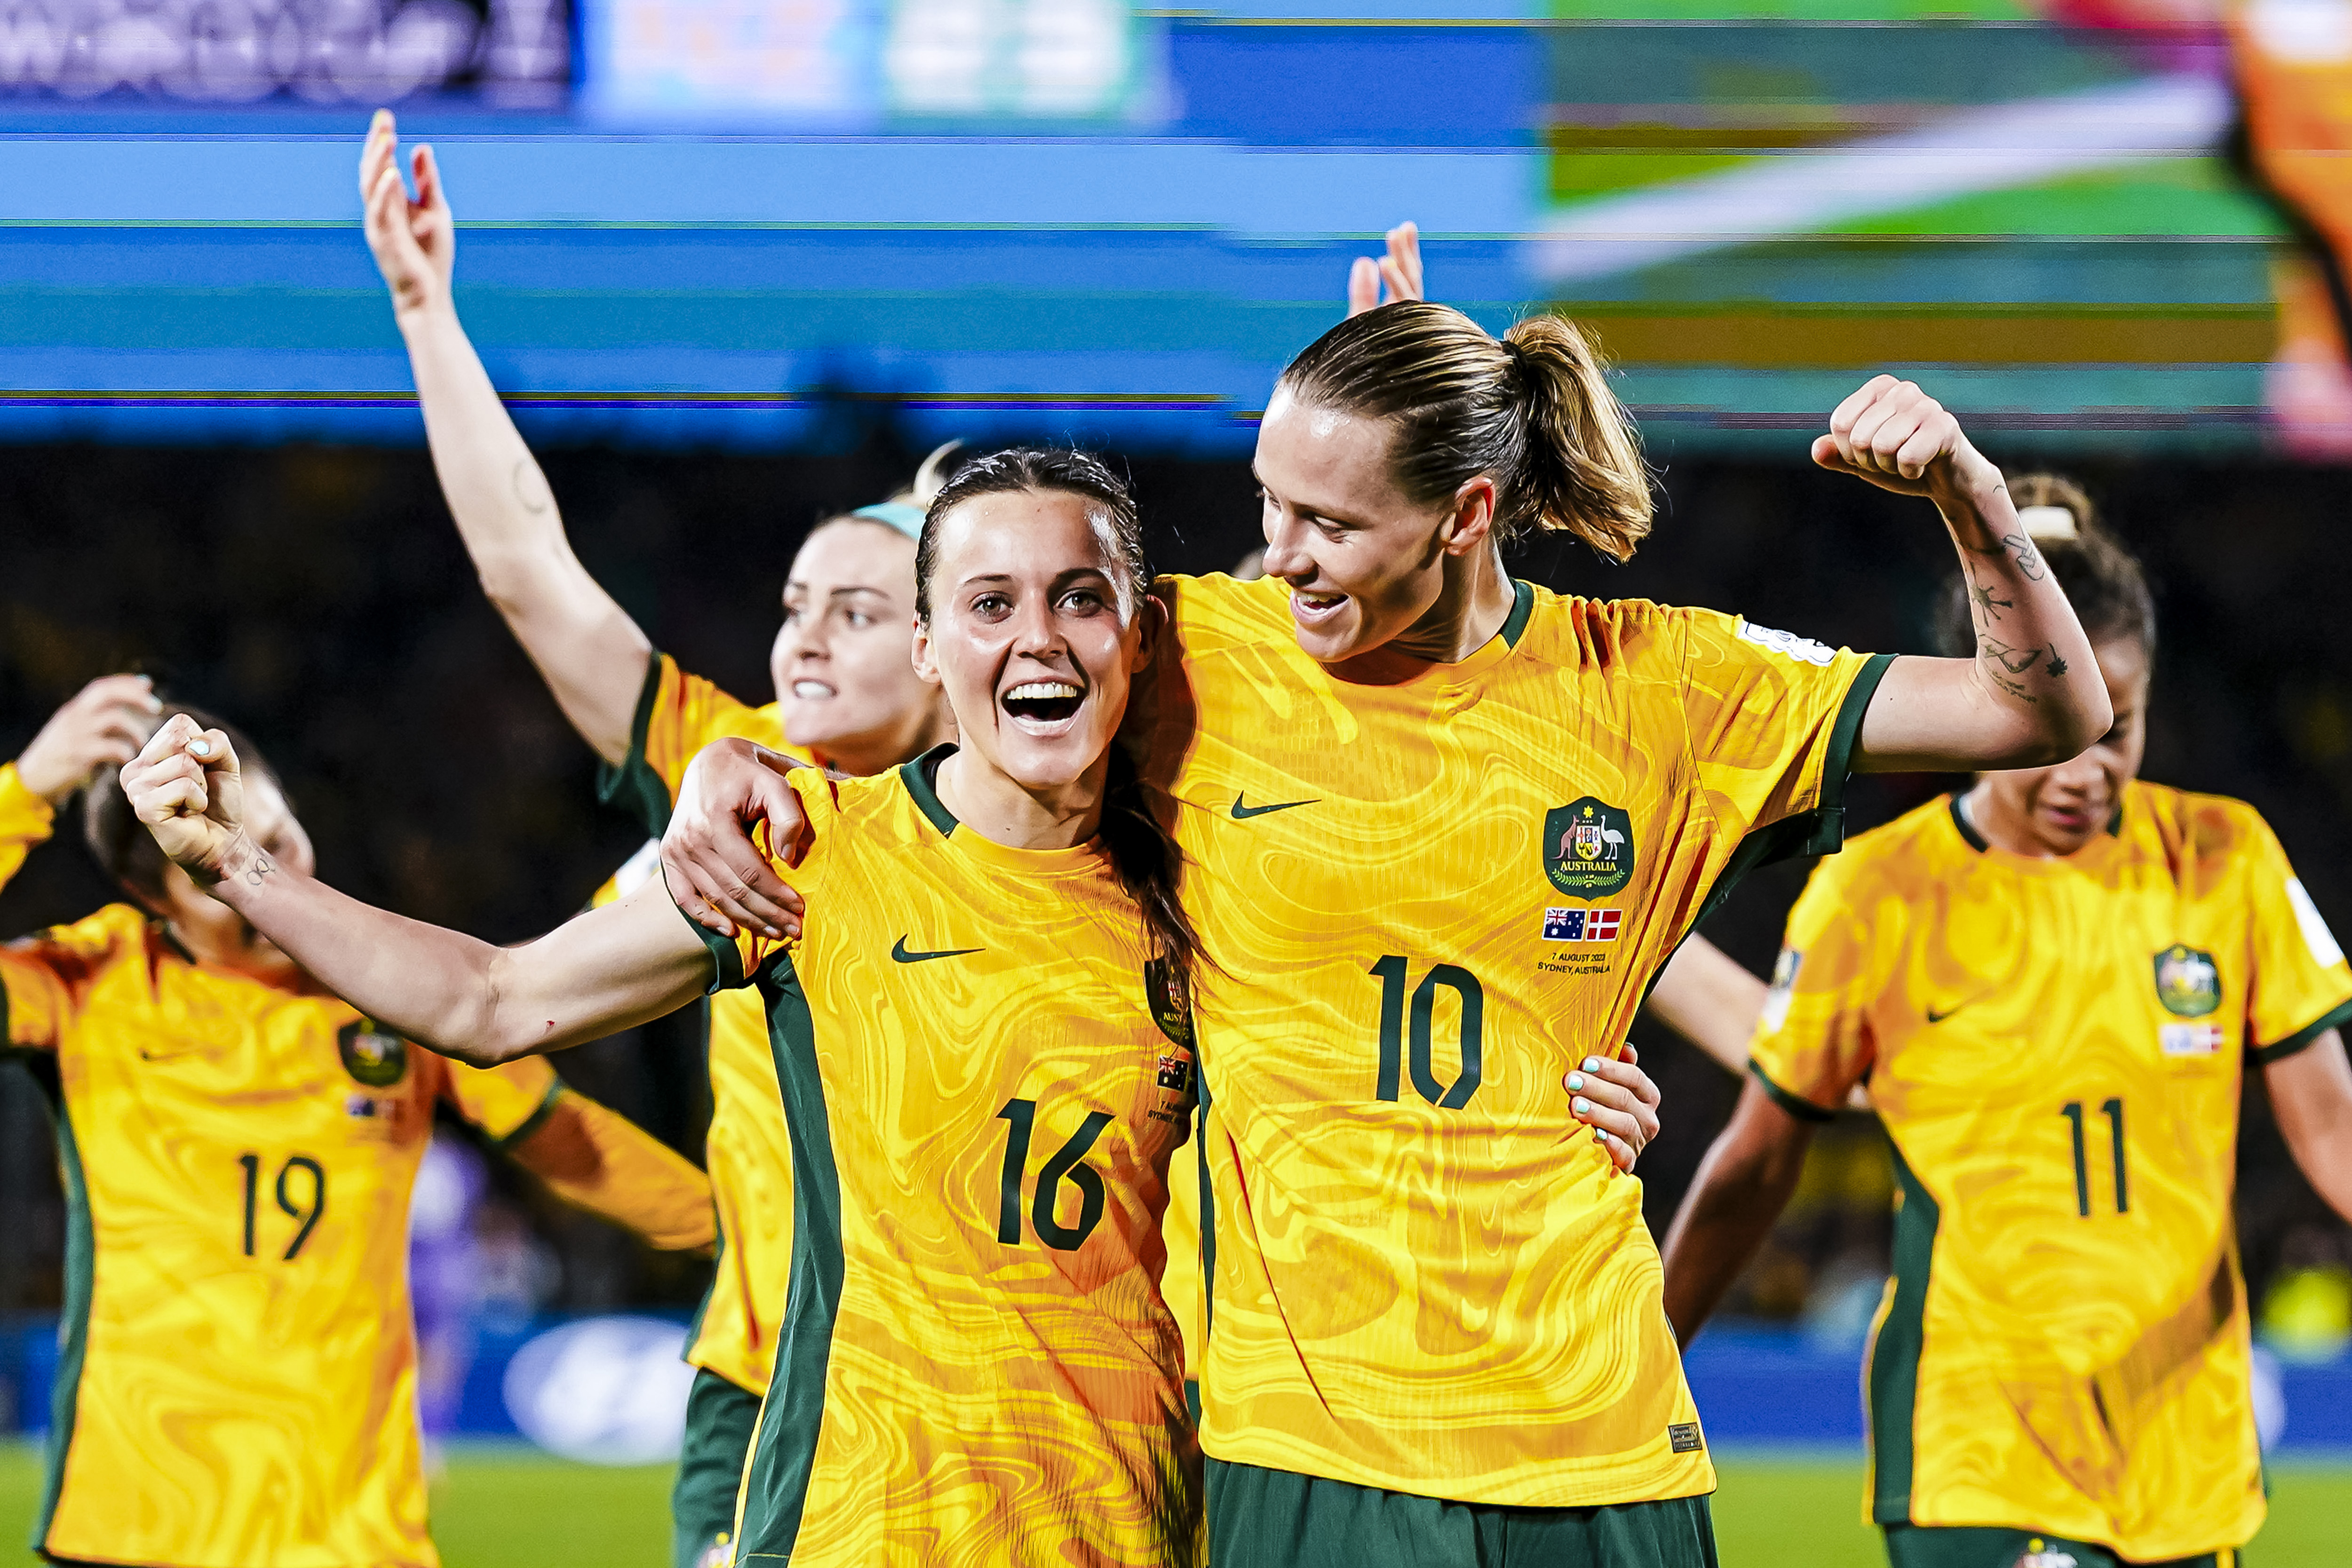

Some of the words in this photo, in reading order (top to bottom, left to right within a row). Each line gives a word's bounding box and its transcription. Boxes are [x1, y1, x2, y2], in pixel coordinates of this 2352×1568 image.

[1560, 861, 1617, 871] AUSTRALIA
[1558, 953, 1590, 962] AUGUST
[1574, 965, 1610, 974] AUSTRALIA
[1368, 955, 1483, 1110] 10
[240, 1155, 324, 1261] 19
[996, 1098, 1116, 1251] 16
[2060, 1099, 2128, 1216] 11
